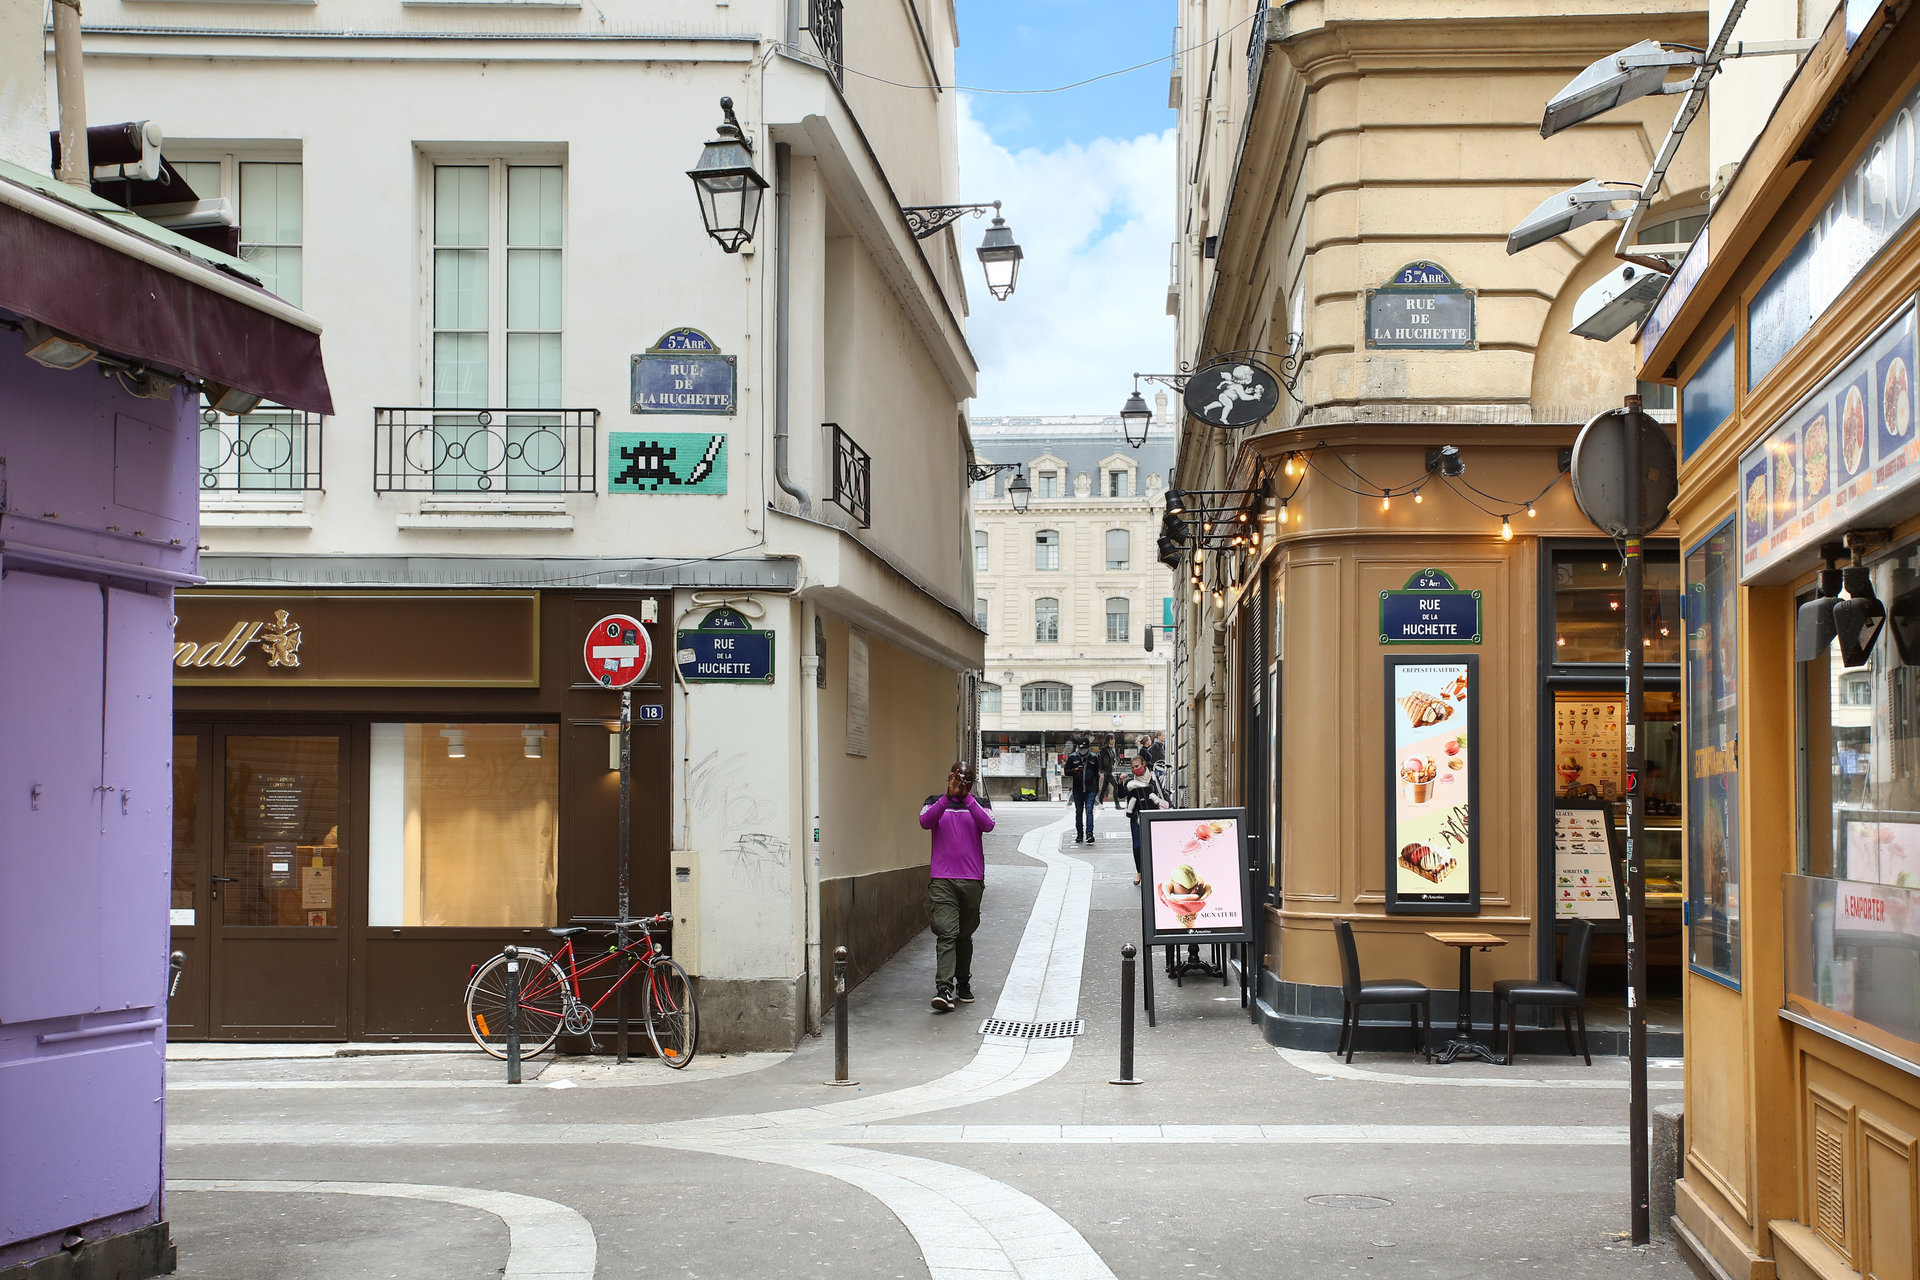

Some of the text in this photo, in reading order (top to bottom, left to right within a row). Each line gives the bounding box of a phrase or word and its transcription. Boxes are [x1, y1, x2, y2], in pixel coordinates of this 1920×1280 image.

[1406, 299, 1436, 310] RUE
[1411, 314, 1430, 324] DE
[1374, 328, 1467, 340] LA HUCHETTE
[670, 364, 699, 376] RUE
[675, 380, 693, 390] DE
[639, 393, 729, 406] LA HUCHETTE
[1419, 599, 1441, 610] RUE
[1403, 624, 1457, 635] HUCHETTE
[173, 615, 263, 667] ndt
[714, 638, 735, 650] RUE
[698, 663, 751, 674] HUCHETTE
[645, 707, 658, 718] 18
[1850, 895, 1885, 922] EMPORTER
